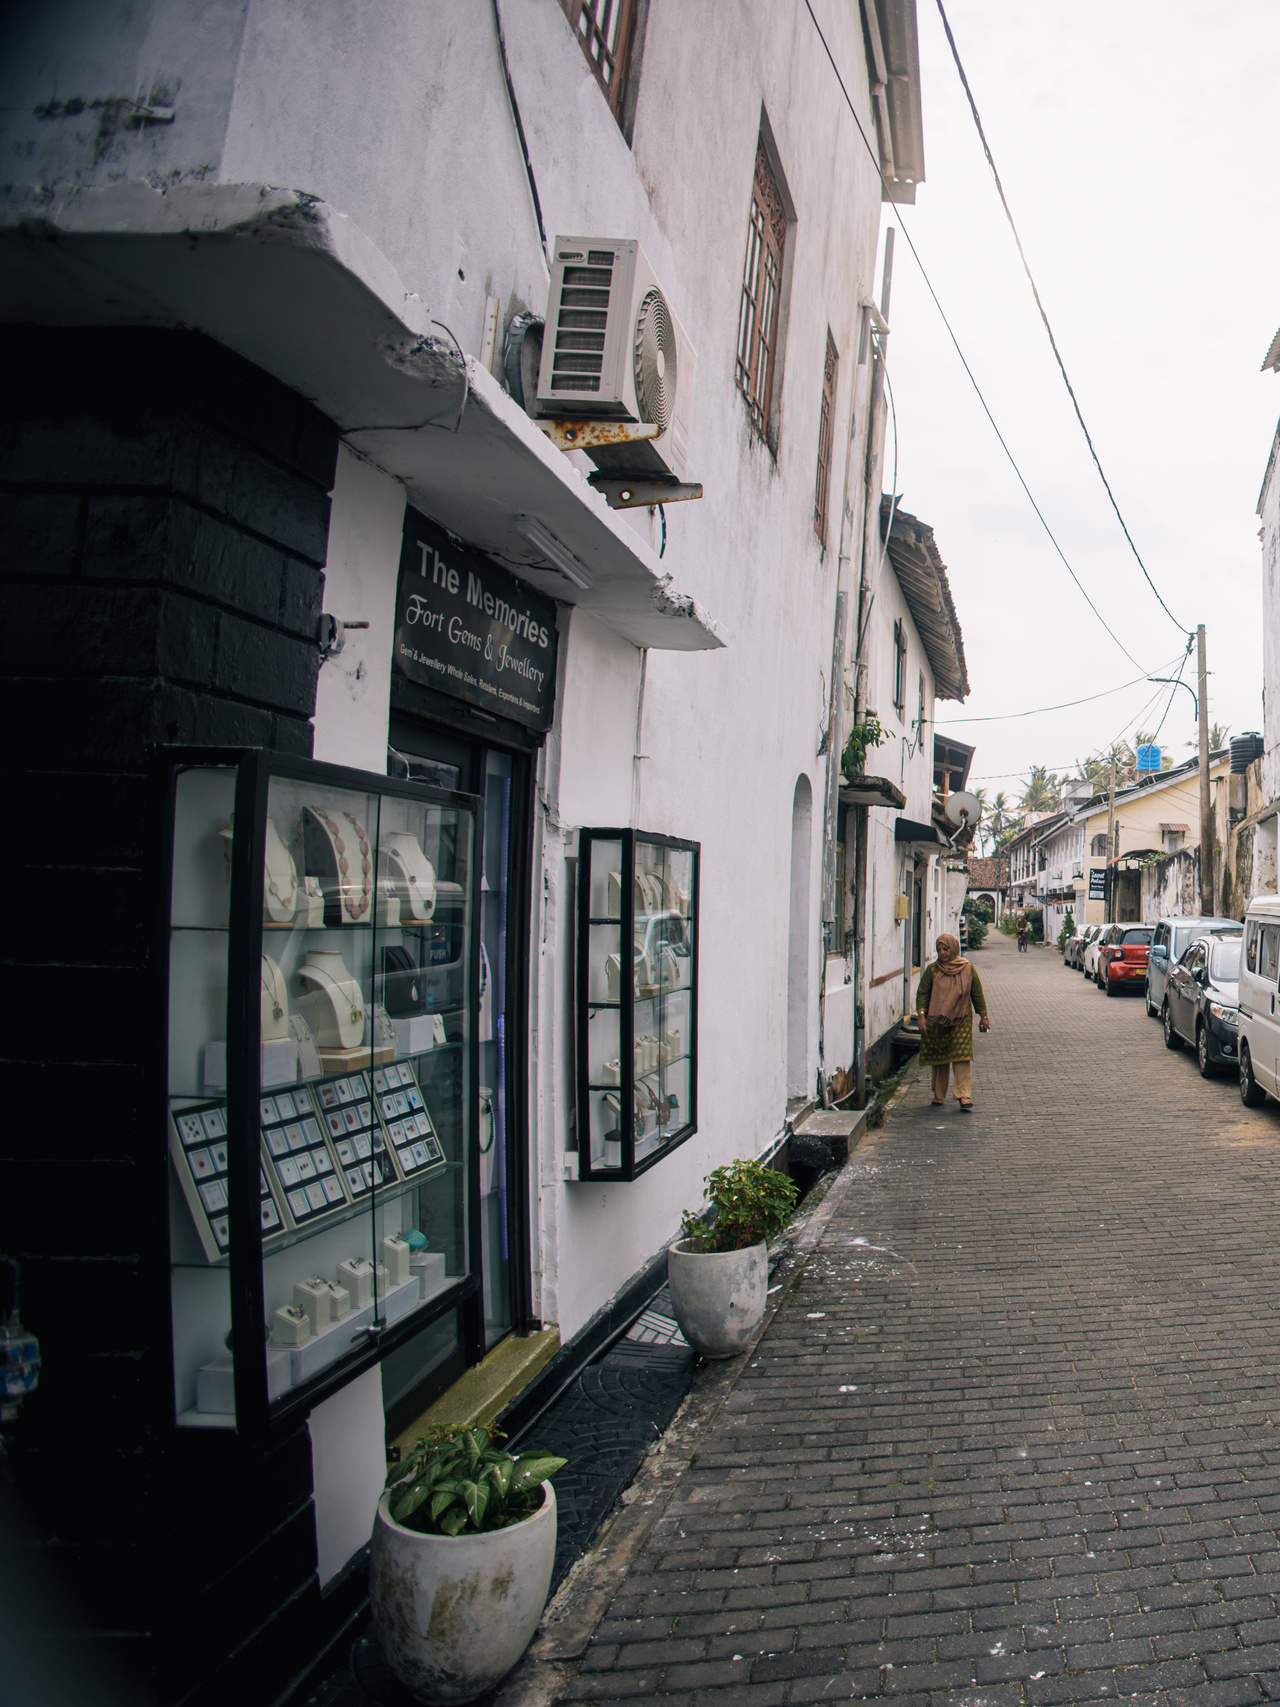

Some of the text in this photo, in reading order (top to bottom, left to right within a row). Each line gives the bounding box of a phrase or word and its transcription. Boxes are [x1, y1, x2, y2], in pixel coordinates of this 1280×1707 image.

[406, 594, 545, 692] Fort Gems & Jewellery
[416, 540, 549, 648] The Memories
[413, 649, 419, 660] &
[419, 652, 447, 674] Jewellery
[447, 663, 464, 680] Whole
